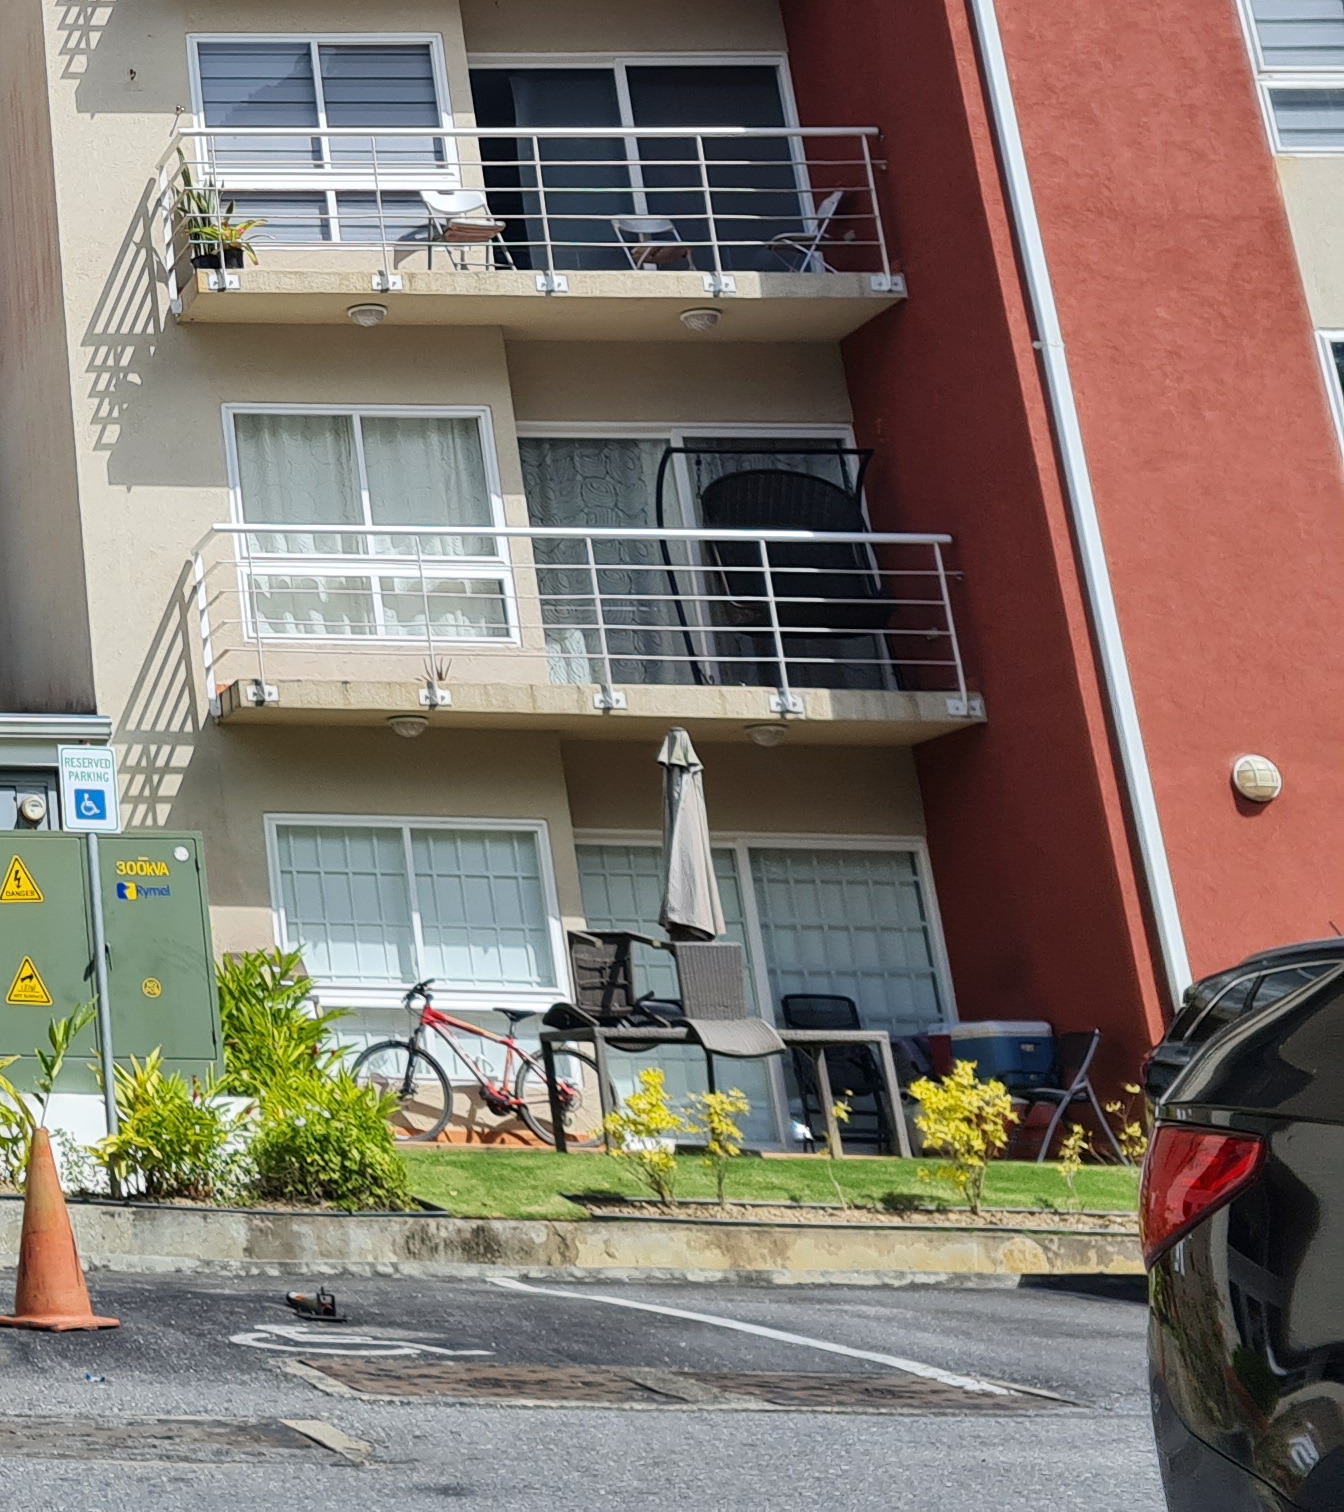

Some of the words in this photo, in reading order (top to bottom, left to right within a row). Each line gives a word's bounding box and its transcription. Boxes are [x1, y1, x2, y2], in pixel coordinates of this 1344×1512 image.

[64, 757, 111, 769] RESERVED
[68, 771, 110, 783] PARKING
[137, 884, 171, 899] Rymel
